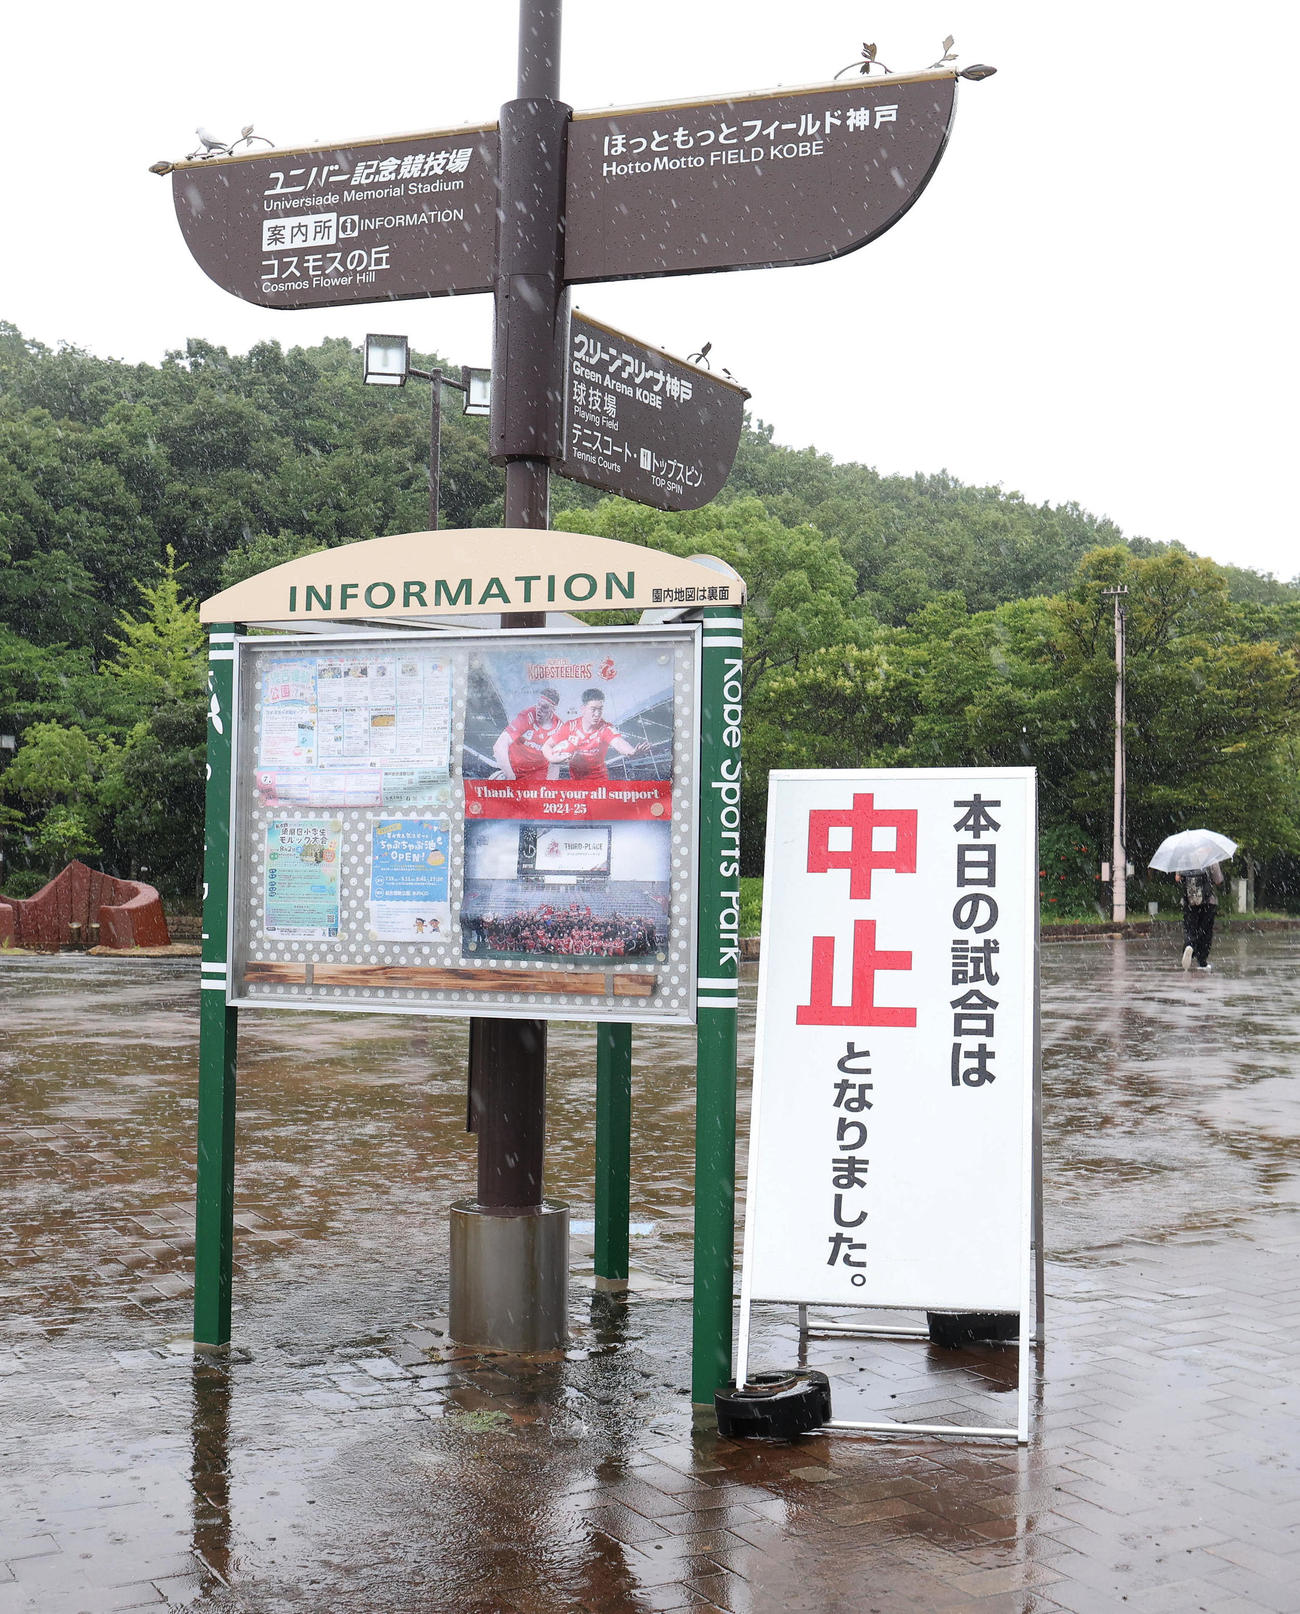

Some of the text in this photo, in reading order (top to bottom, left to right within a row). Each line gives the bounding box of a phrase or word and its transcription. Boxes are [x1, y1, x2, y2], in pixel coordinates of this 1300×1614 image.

[603, 104, 898, 156] ほっともっとフィールド神戸
[710, 147, 764, 166] FIELD
[770, 140, 824, 161] KOBE
[264, 147, 473, 196] ユニバー記念競技場
[264, 178, 464, 211] Universiade Memorial Stadium
[266, 218, 333, 247] 案内所
[360, 208, 464, 231] INFORMATION
[261, 245, 391, 280] コスモスの丘
[262, 271, 376, 293] Cosmos Flower Hill
[573, 333, 693, 403] グリーンアリーナ神戸
[573, 361, 663, 410] Green Arena KOBE
[573, 380, 617, 418] 球技場
[574, 405, 619, 431] Playing Field
[572, 446, 621, 473] Tennis Courts
[652, 452, 703, 488] トップスピン
[651, 475, 684, 495] TOP SPIN
[289, 570, 636, 613] INFORMATION
[652, 585, 730, 603] 園内地図は裏面
[474, 786, 660, 803] Thank you for your all support
[543, 803, 587, 815] 2024-25
[712, 759, 742, 878] Sports
[950, 794, 1002, 1088] 本日の試合は
[796, 793, 918, 1288] 中止 となりました。
